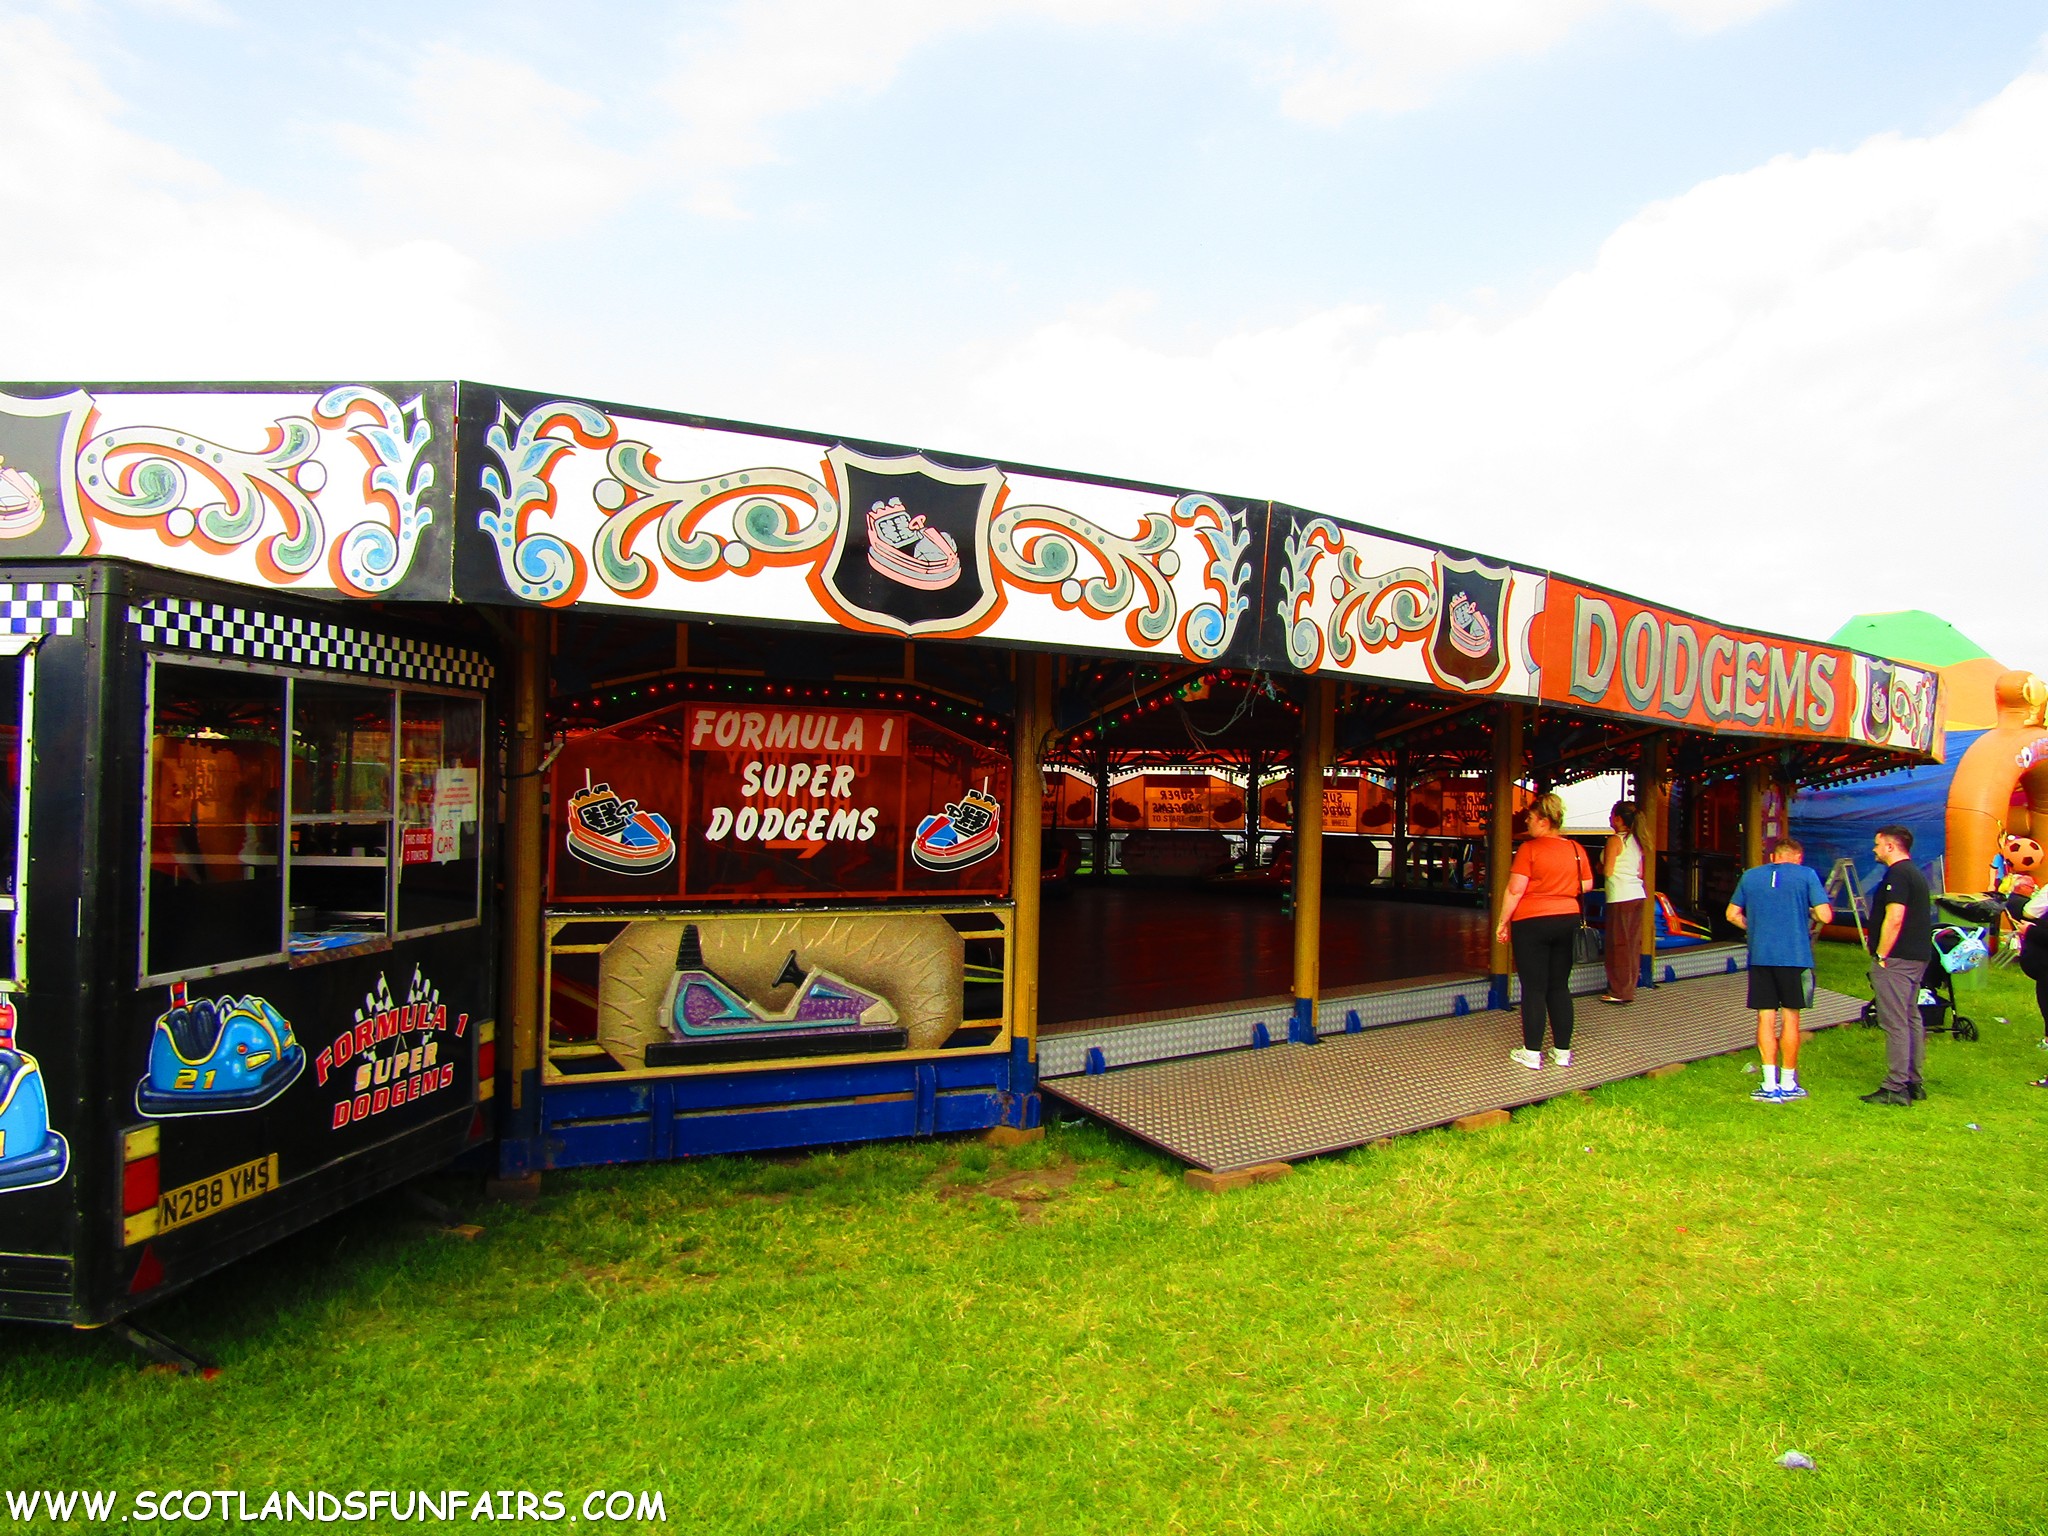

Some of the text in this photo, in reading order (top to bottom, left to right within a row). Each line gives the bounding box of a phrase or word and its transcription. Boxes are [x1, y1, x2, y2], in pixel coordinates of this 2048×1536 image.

[1569, 593, 1838, 732] DODGEMS
[692, 711, 894, 751] FORMULA 1
[741, 761, 855, 798] SUPER
[405, 834, 416, 845] THIS
[416, 833, 427, 844] RIDE
[441, 819, 454, 831] PER
[705, 807, 879, 841] DODGEMS
[411, 850, 429, 861] TOKENS
[437, 836, 455, 854] CAR
[316, 1003, 469, 1087] FORMULA 1
[174, 1068, 216, 1089] 21
[355, 1041, 438, 1092] SUPER
[332, 1062, 454, 1130] DODGEMS
[163, 1161, 270, 1227] N288 YMS
